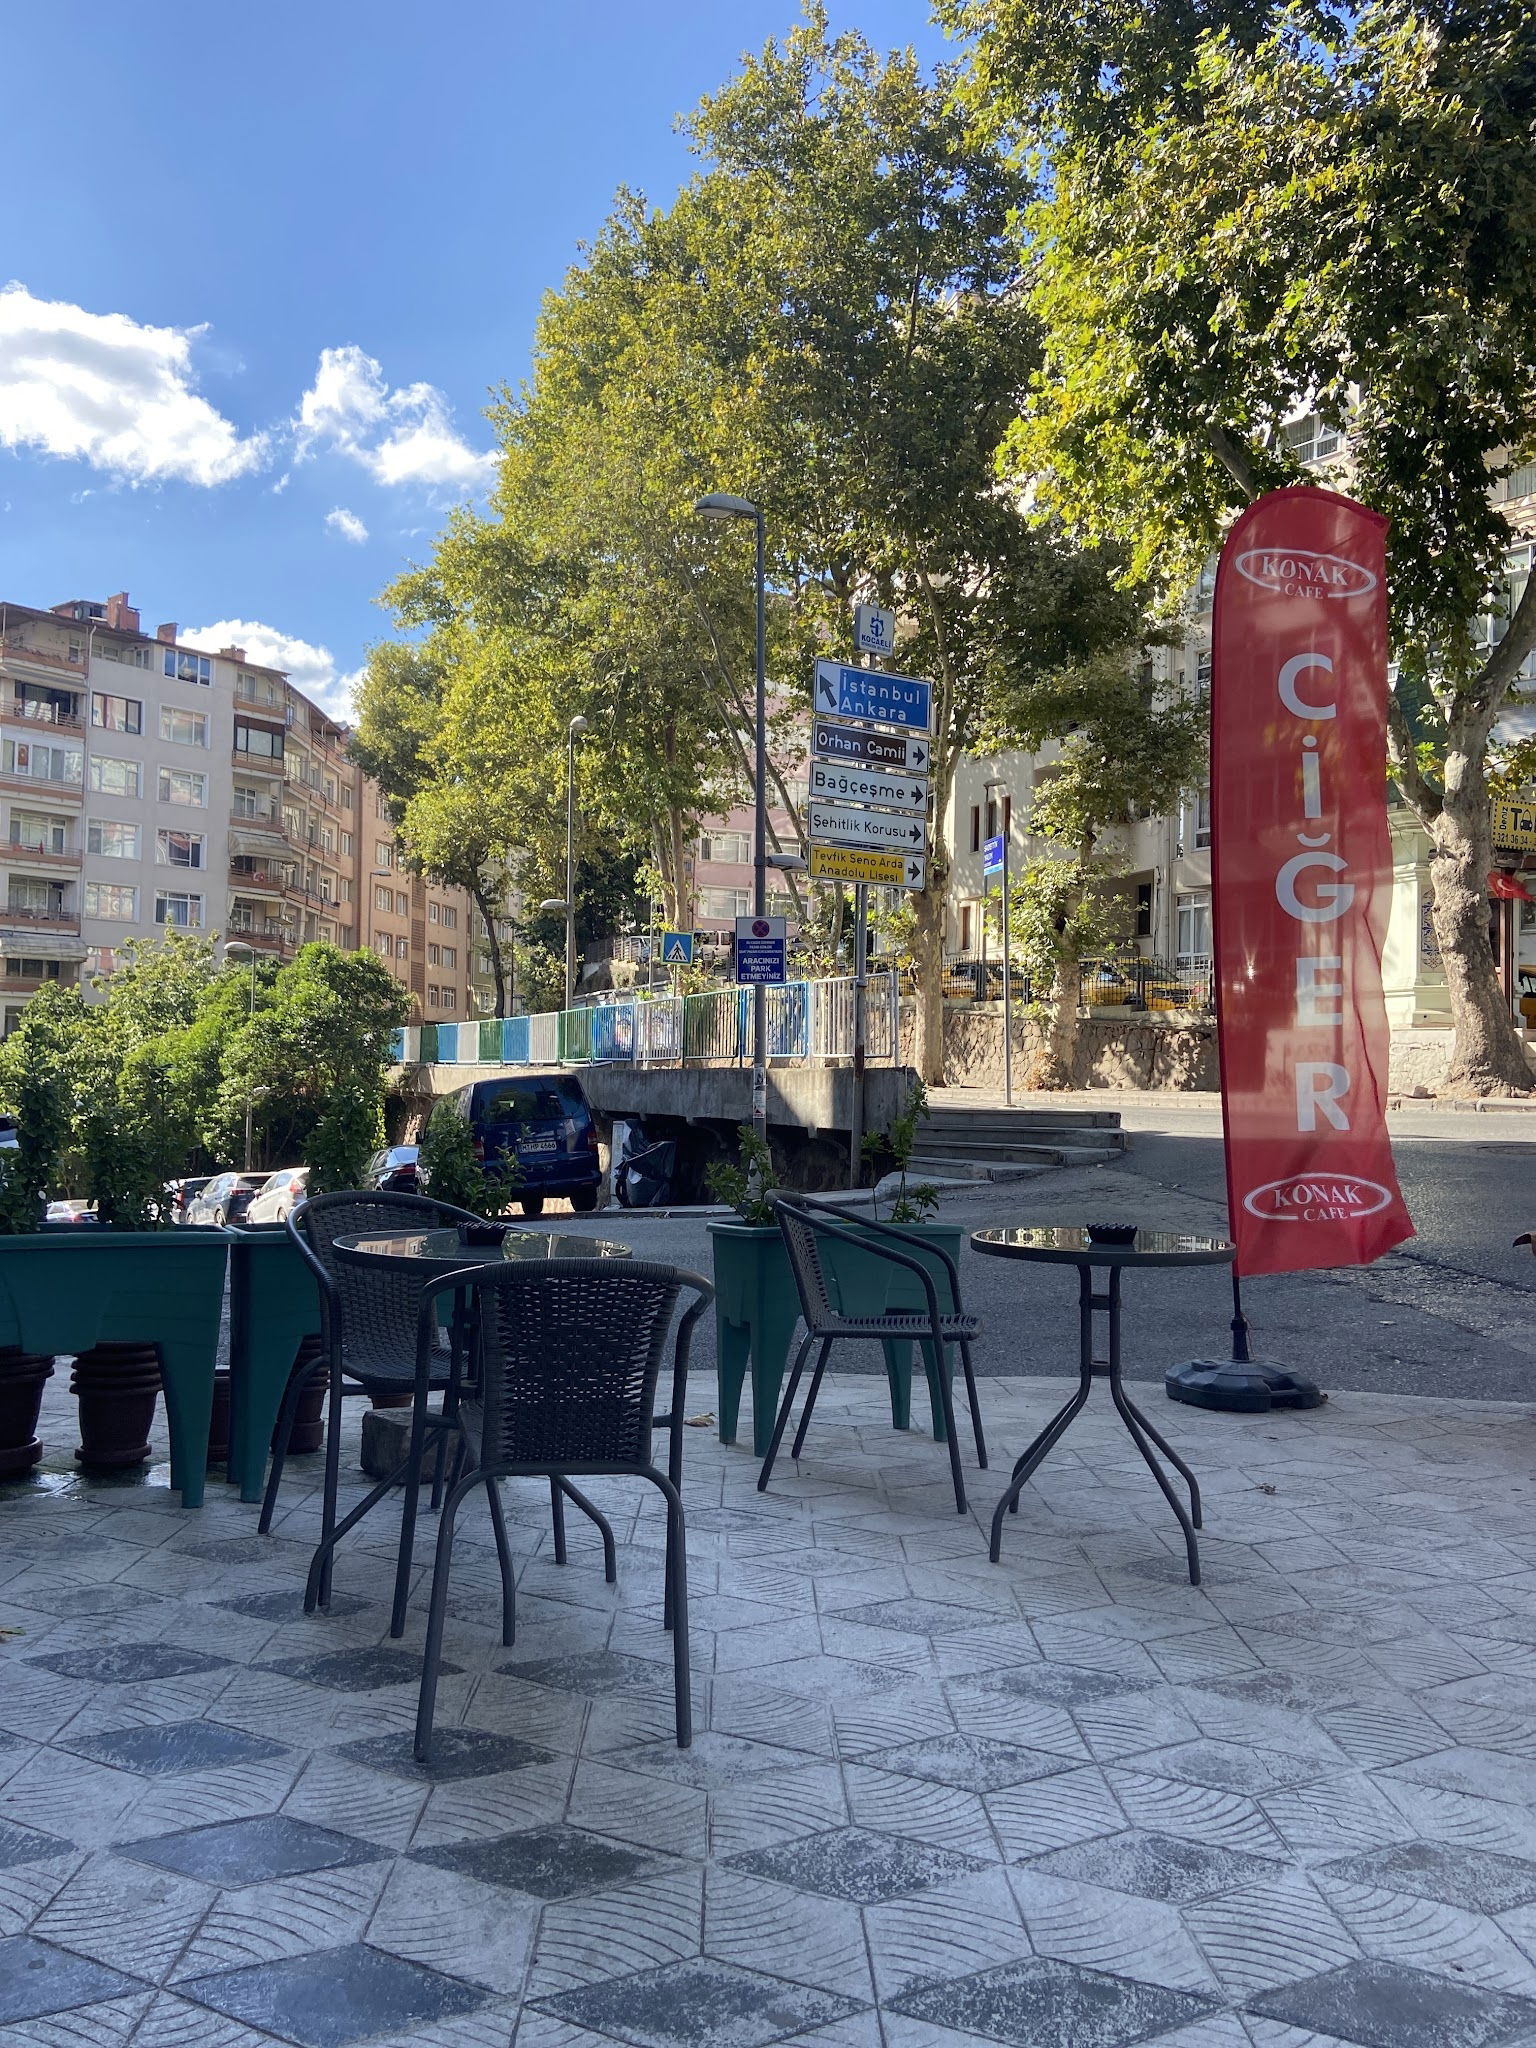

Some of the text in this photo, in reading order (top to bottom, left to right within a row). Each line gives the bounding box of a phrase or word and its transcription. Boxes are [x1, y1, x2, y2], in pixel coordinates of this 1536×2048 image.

[1261, 556, 1348, 586] KONAK
[1284, 583, 1323, 599] CAFE
[842, 673, 920, 705] İstanbul
[841, 697, 906, 721] Ankara
[818, 732, 905, 760] Orhan Camii
[815, 771, 905, 799] Bağçeşme
[813, 815, 906, 838] Şehitlik Korusu
[1511, 835, 1518, 844] 36
[814, 850, 903, 869] Tevfik Seno Arda
[819, 864, 898, 882] Anadolu Lisesi
[1275, 653, 1355, 1131] CİĞER
[741, 972, 781, 980] ETMEYİNİZ
[1274, 1183, 1361, 1208] KONAK
[1303, 1206, 1348, 1222] CAFE
